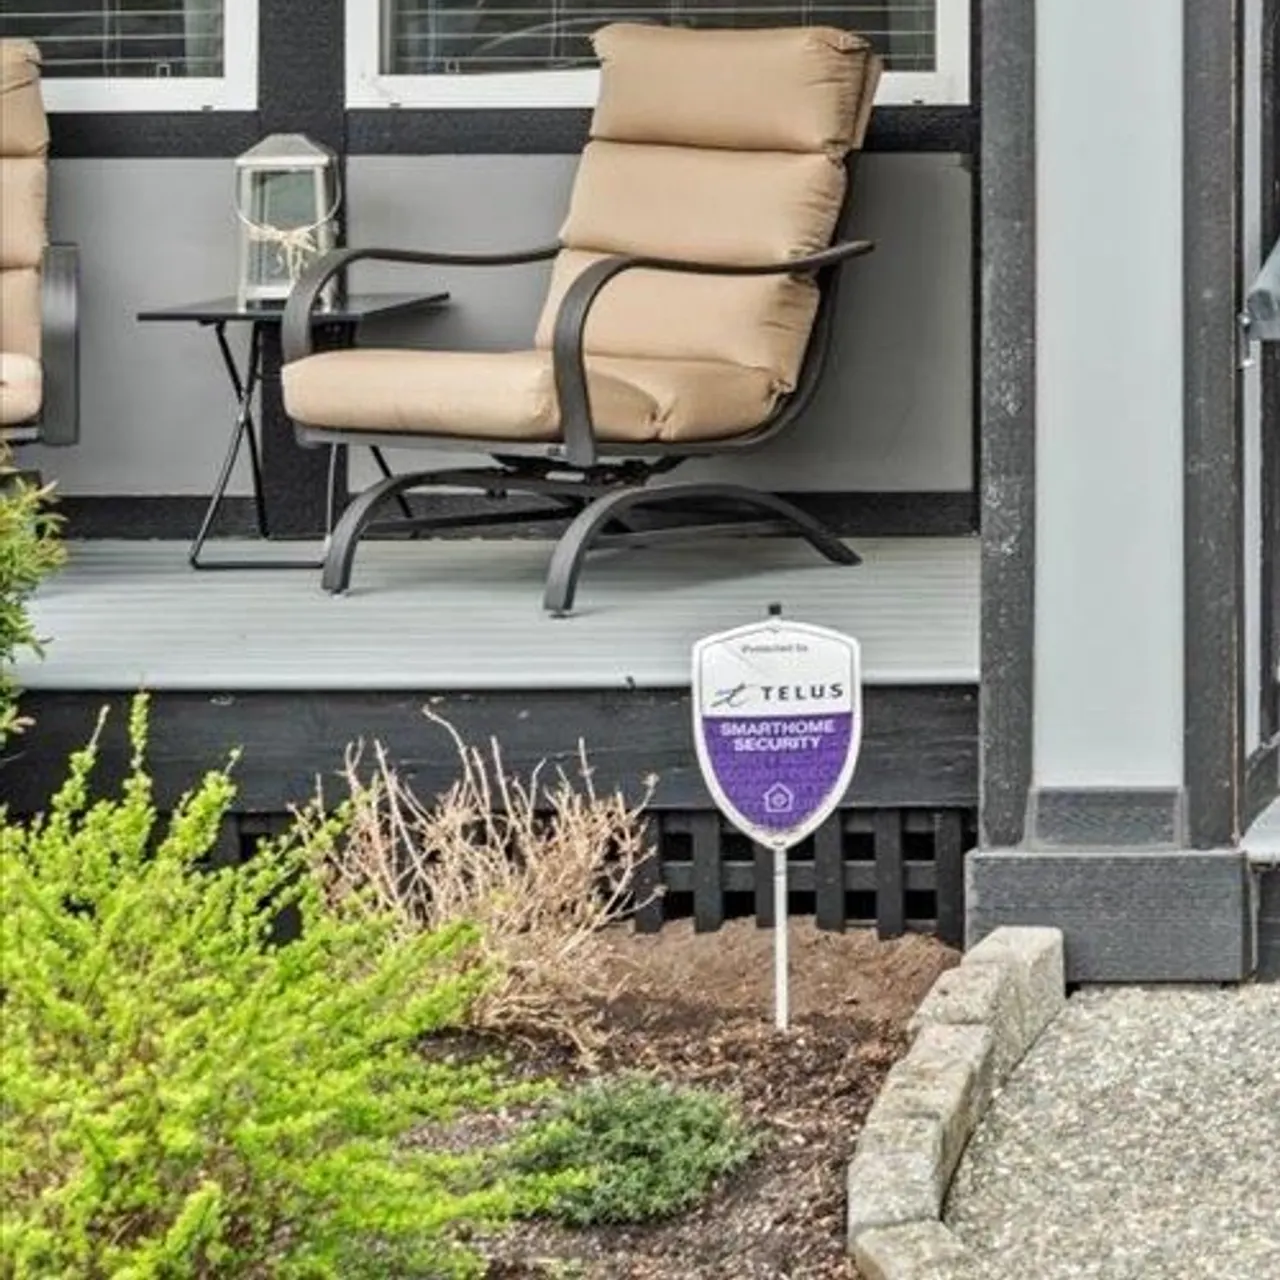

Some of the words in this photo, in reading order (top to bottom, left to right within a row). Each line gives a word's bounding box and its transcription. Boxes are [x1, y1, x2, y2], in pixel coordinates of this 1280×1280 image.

[760, 683, 844, 700] TELUS
[721, 720, 836, 736] SMARTHOME
[733, 736, 821, 751] SECURITY
